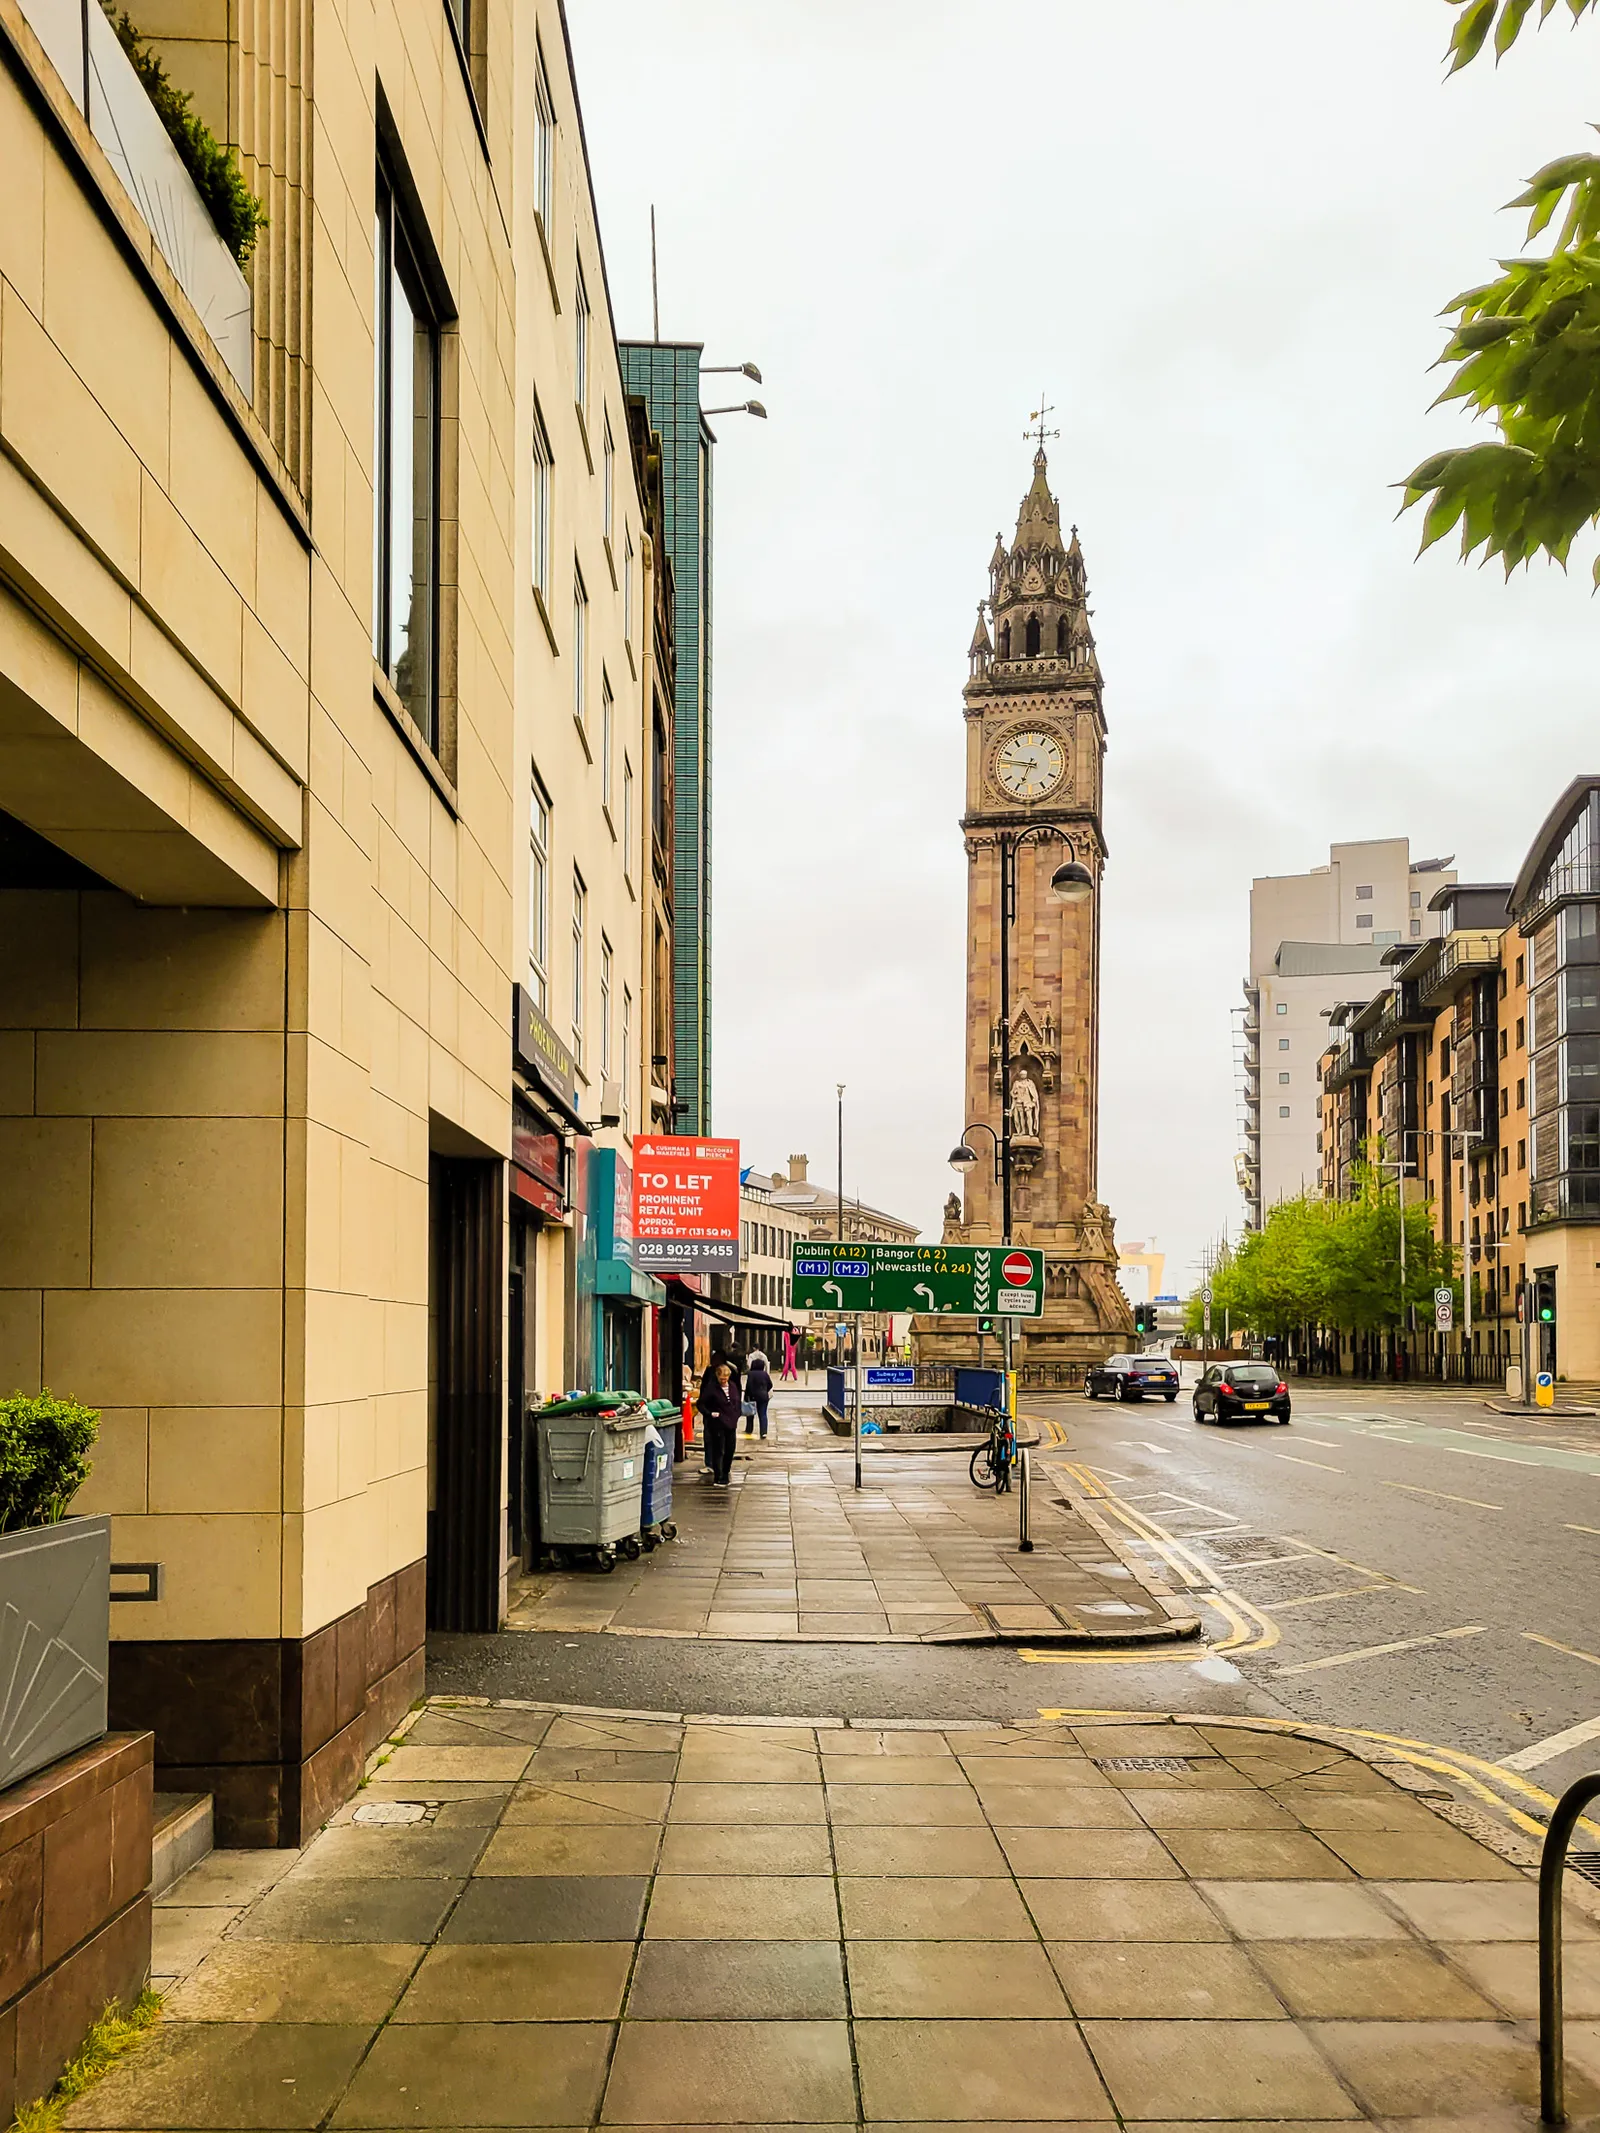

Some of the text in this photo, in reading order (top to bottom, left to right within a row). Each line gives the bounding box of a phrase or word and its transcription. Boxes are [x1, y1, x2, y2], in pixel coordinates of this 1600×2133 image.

[529, 1010, 557, 1065] PHOENIX
[638, 1173, 712, 1190] TO LET
[639, 1194, 701, 1205] PROMINENT
[639, 1206, 703, 1216] RETAIL UNIT
[639, 1218, 676, 1226] APPROX.
[639, 1227, 659, 1235] 1,412
[661, 1227, 674, 1235] SQ
[689, 1228, 704, 1236] (131
[706, 1228, 718, 1236] SQ
[720, 1229, 731, 1237] M)
[638, 1244, 733, 1256] 028 9023 3455
[796, 1246, 830, 1256] Dublin
[876, 1248, 914, 1260] Bangor
[876, 1261, 932, 1272] Newcastle
